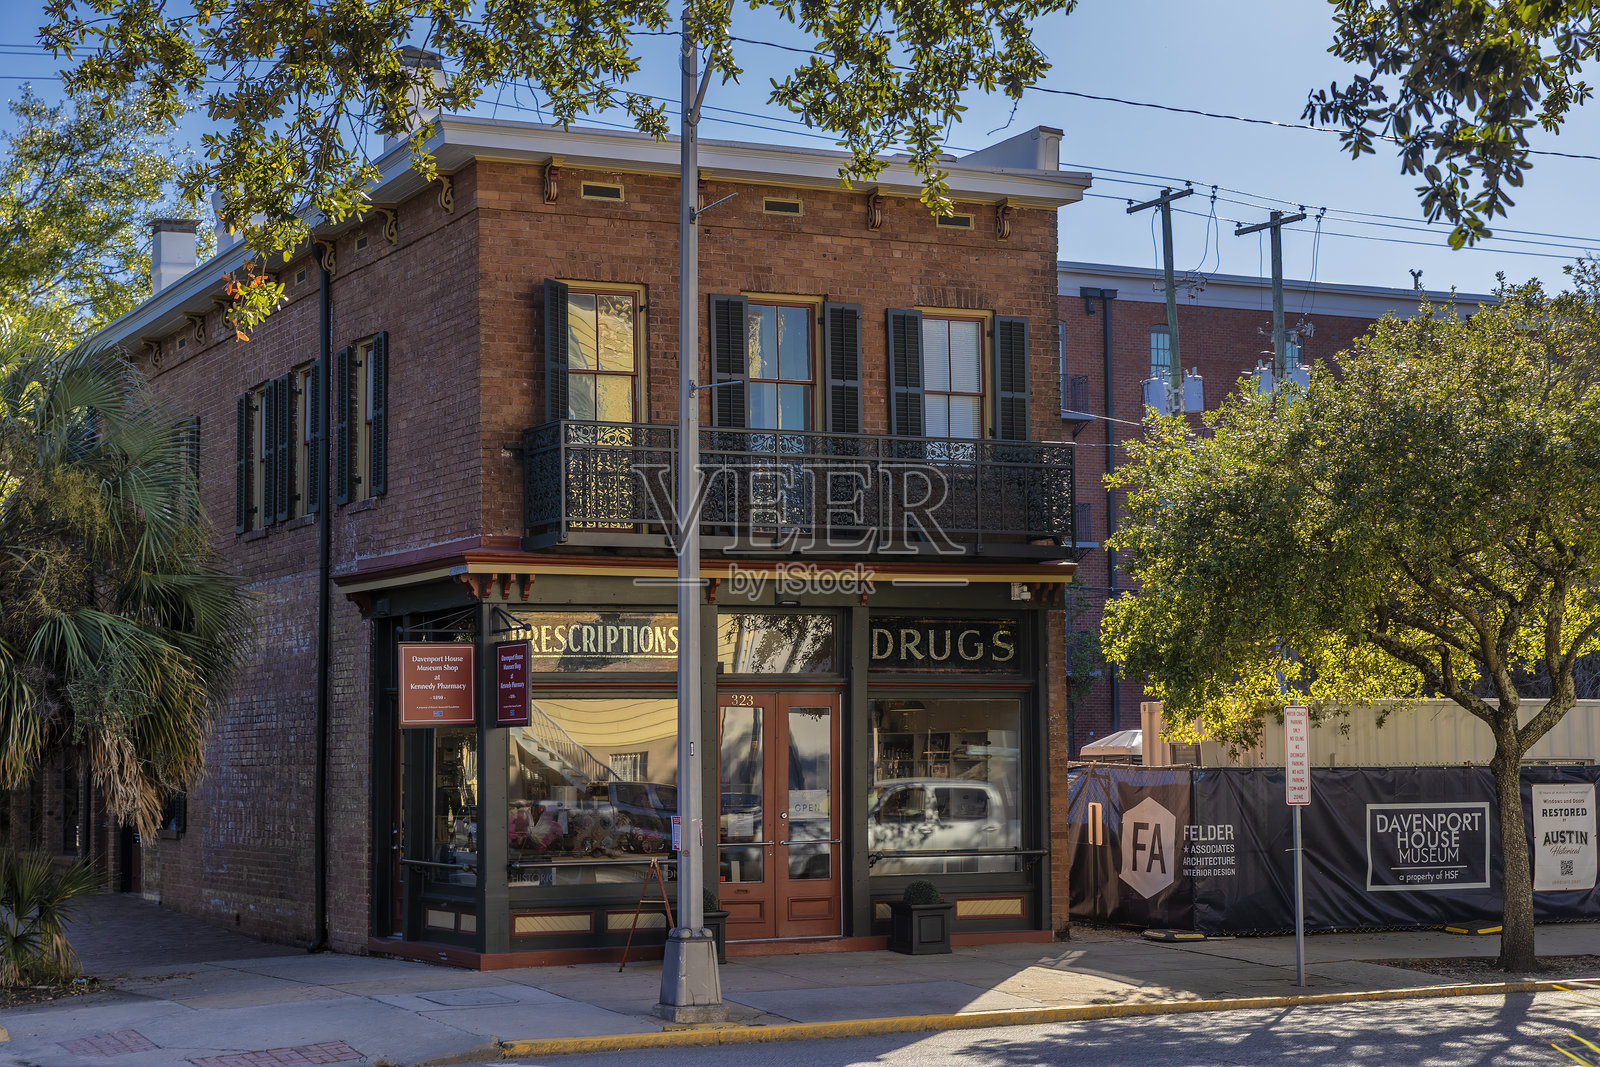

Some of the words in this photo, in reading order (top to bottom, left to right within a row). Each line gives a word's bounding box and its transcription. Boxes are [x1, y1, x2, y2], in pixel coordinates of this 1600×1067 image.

[872, 628, 1015, 662] DRUGS
[412, 655, 443, 664] Davenport
[443, 664, 459, 673] Shop
[410, 683, 436, 691] Kennedy
[437, 683, 466, 691] Pharmacy
[731, 694, 755, 707] 323
[795, 803, 820, 812] OPEN
[1542, 807, 1588, 818] RESTORED
[1376, 812, 1482, 833] DAVENPORT
[1183, 824, 1235, 841] FELDER
[1543, 830, 1588, 846] AUSTIN
[1397, 830, 1460, 849] HOUSE
[1131, 821, 1166, 874] FA
[1190, 844, 1235, 854] ASSOCIATES
[1550, 844, 1582, 857] Historical
[1182, 856, 1236, 866] ARCHITECTURE
[1398, 847, 1459, 864] MUSEUM
[1182, 868, 1212, 877] INTERIOR
[1213, 868, 1236, 876] DESIGN
[1406, 872, 1434, 883] property
[1435, 872, 1443, 880] of
[1444, 870, 1459, 880] HSF
